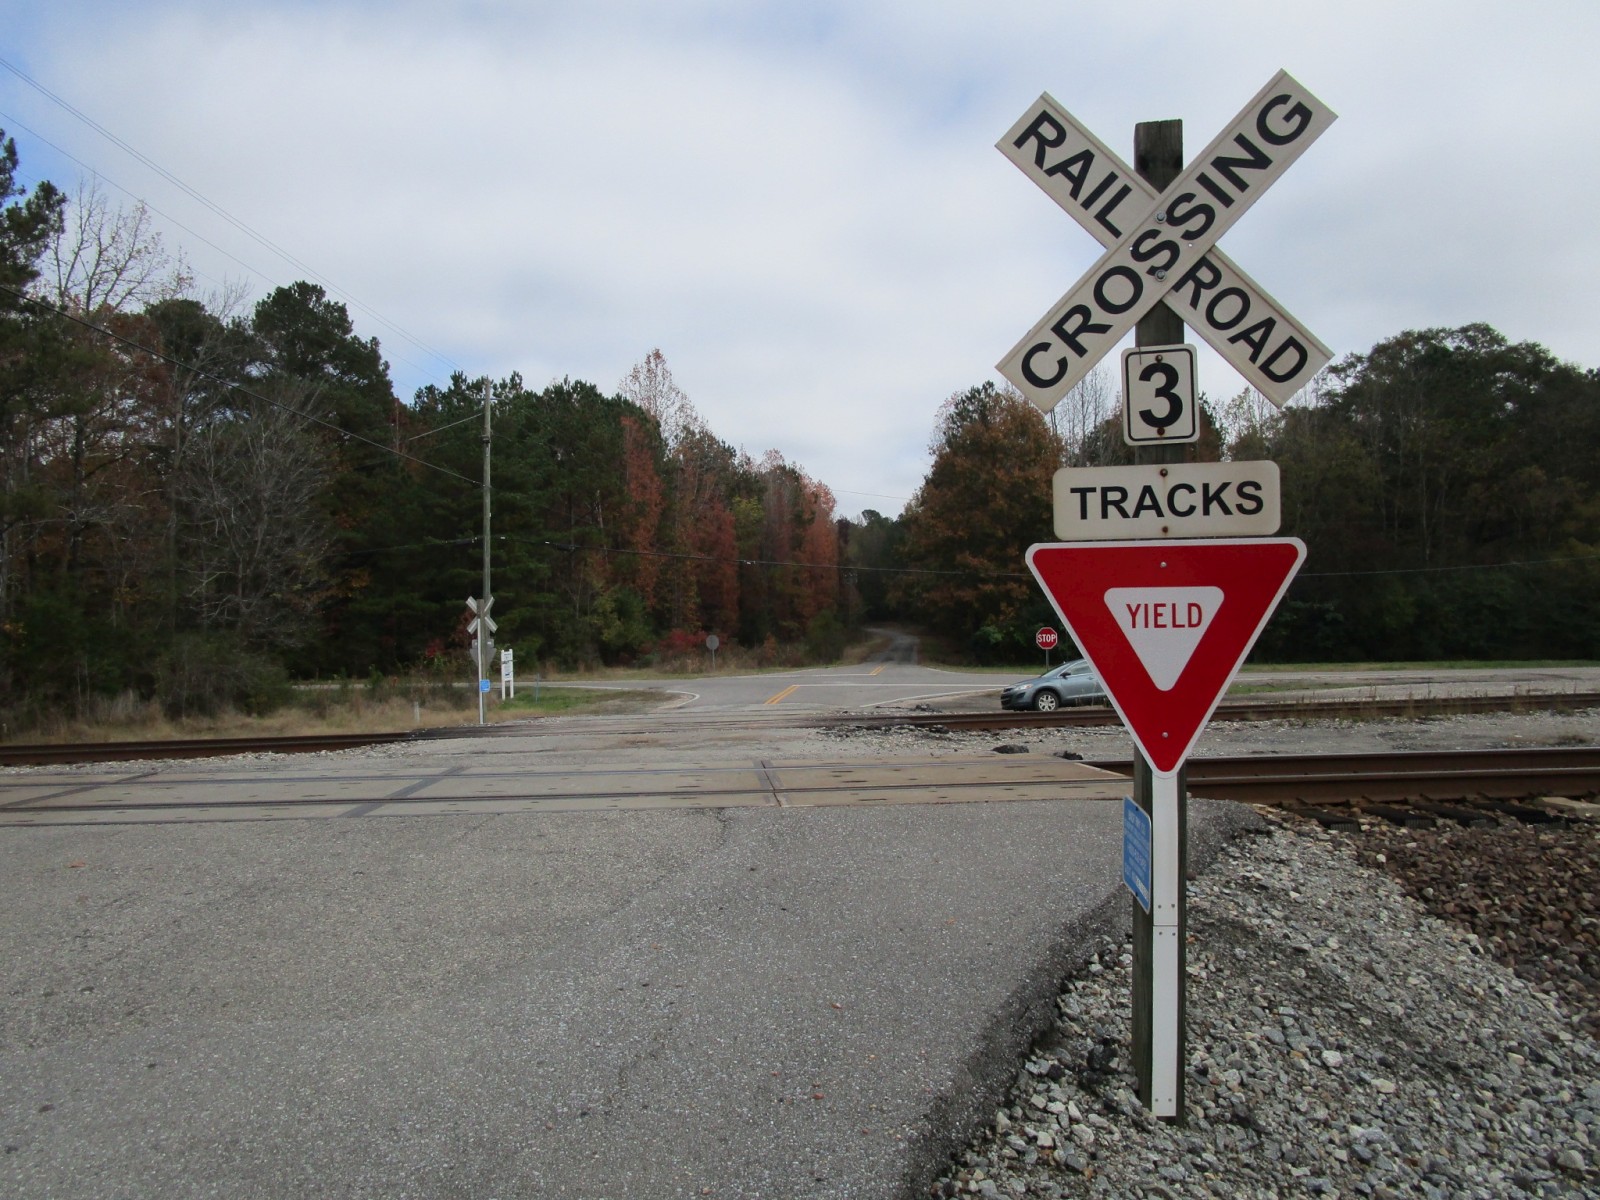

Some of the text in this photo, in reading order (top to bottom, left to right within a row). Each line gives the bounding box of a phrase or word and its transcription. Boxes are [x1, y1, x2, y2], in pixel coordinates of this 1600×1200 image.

[1013, 109, 1308, 383] RAIL ROAD
[1021, 94, 1313, 389] CROSSING
[1139, 362, 1183, 427] 3
[1070, 481, 1264, 520] TRACKS
[1037, 633, 1056, 643] STOP
[1126, 603, 1203, 629] YIELD
